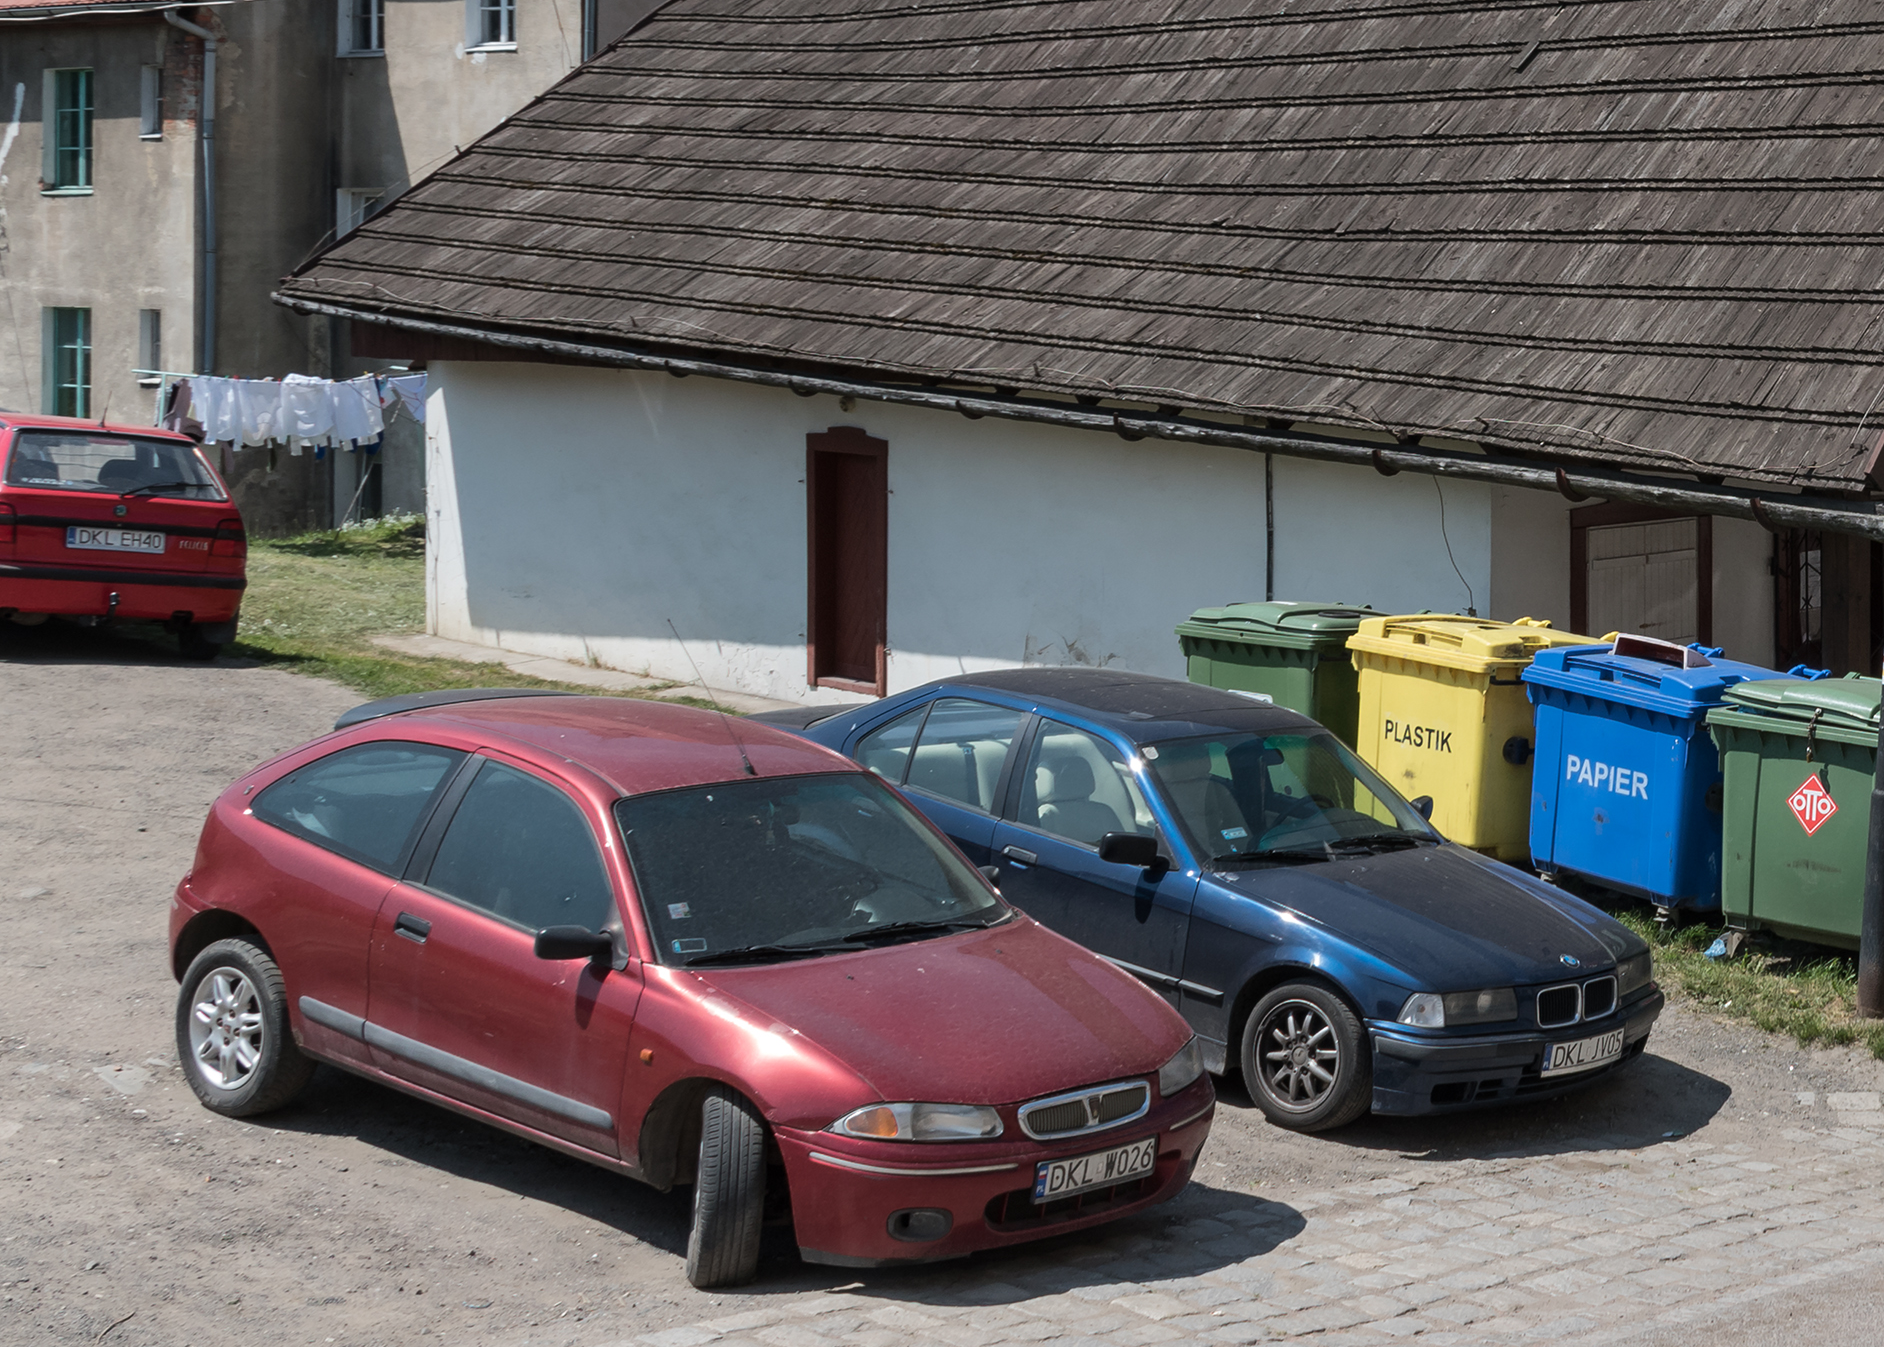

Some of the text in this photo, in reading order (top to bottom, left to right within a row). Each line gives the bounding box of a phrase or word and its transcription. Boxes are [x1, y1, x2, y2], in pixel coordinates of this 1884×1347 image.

[79, 529, 161, 549] DKL EH40
[1384, 719, 1453, 753] PLASTIK
[1566, 754, 1649, 800] PAPIER
[1793, 789, 1831, 821] OTTO
[1553, 1041, 1585, 1068] DKL
[1592, 1030, 1623, 1060] JV05
[1049, 1158, 1093, 1193] DKL
[1104, 1141, 1153, 1180] W026
